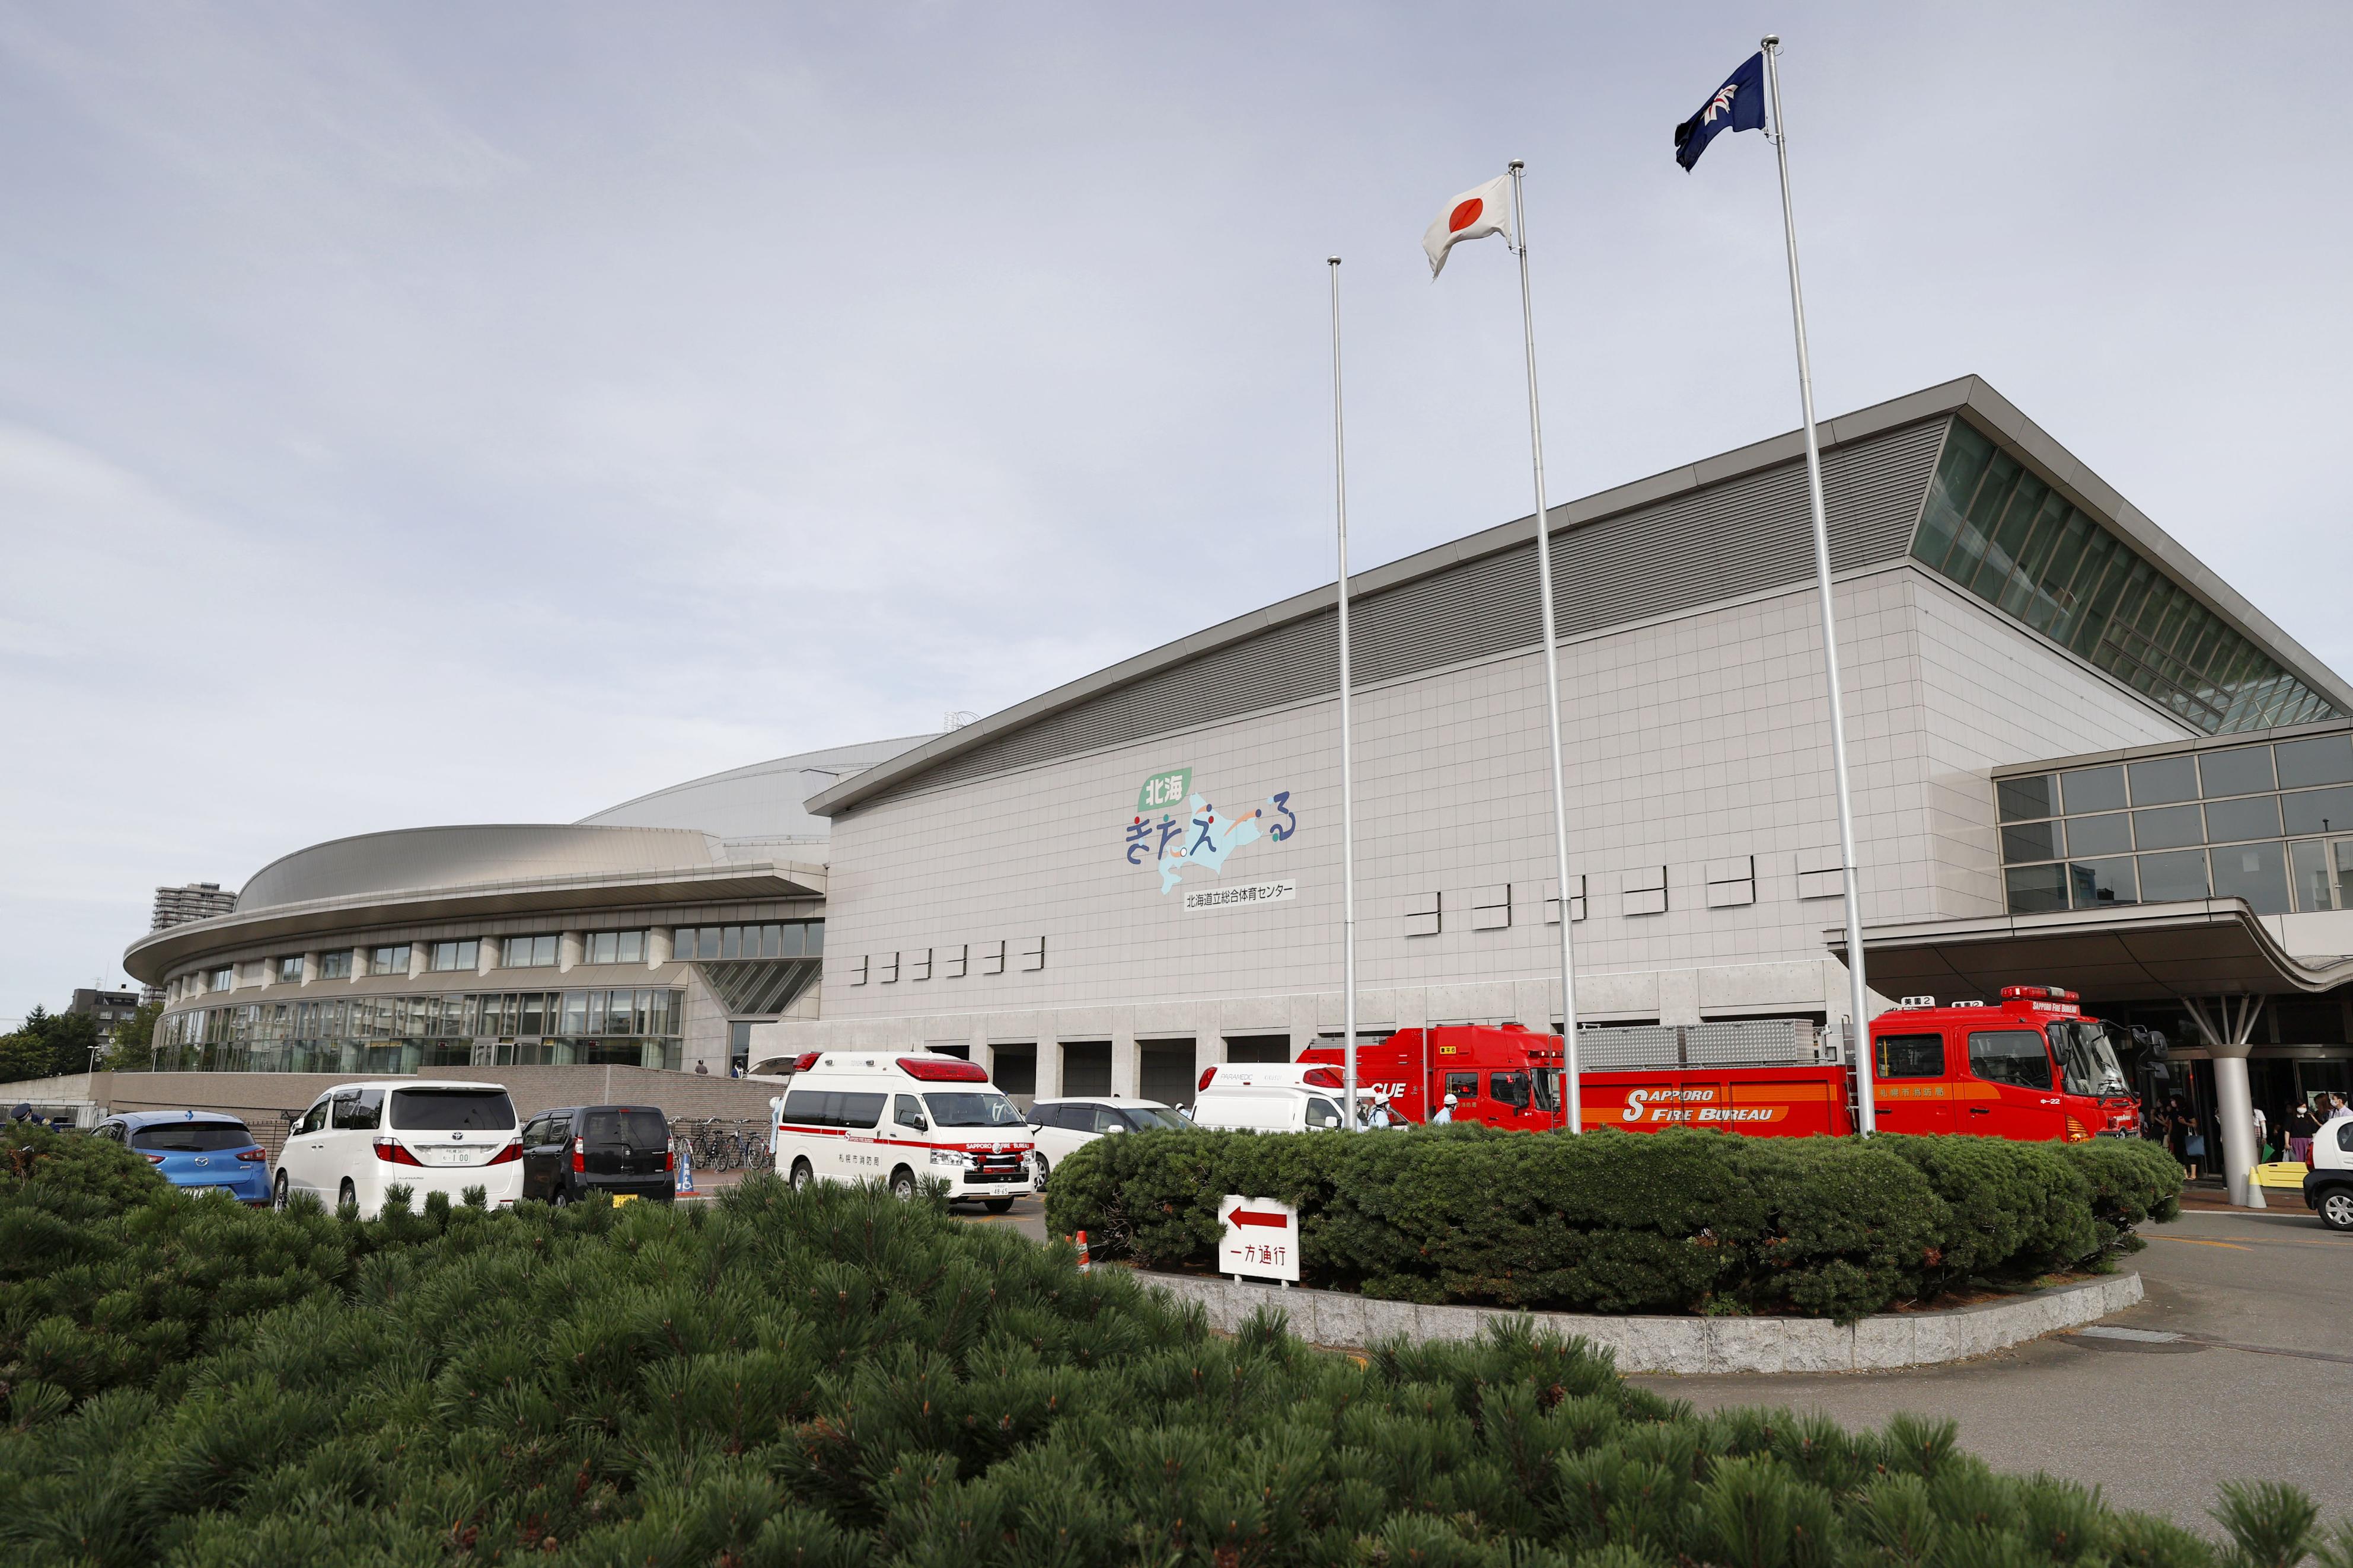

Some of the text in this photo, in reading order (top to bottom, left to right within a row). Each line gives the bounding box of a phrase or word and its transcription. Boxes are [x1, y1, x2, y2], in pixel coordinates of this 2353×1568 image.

[1146, 775, 1182, 806] 北海
[1187, 884, 1293, 908] 北海道立総合体育センター
[2032, 1001, 2077, 1013] SAPPORO FIRE BUREAU
[1880, 1087, 1945, 1097] 札幌市消防局
[1622, 1088, 1714, 1122] SAPPORO
[1650, 1107, 1774, 1122] FIRE BUREAU
[1230, 1244, 1286, 1266] 一方通行
